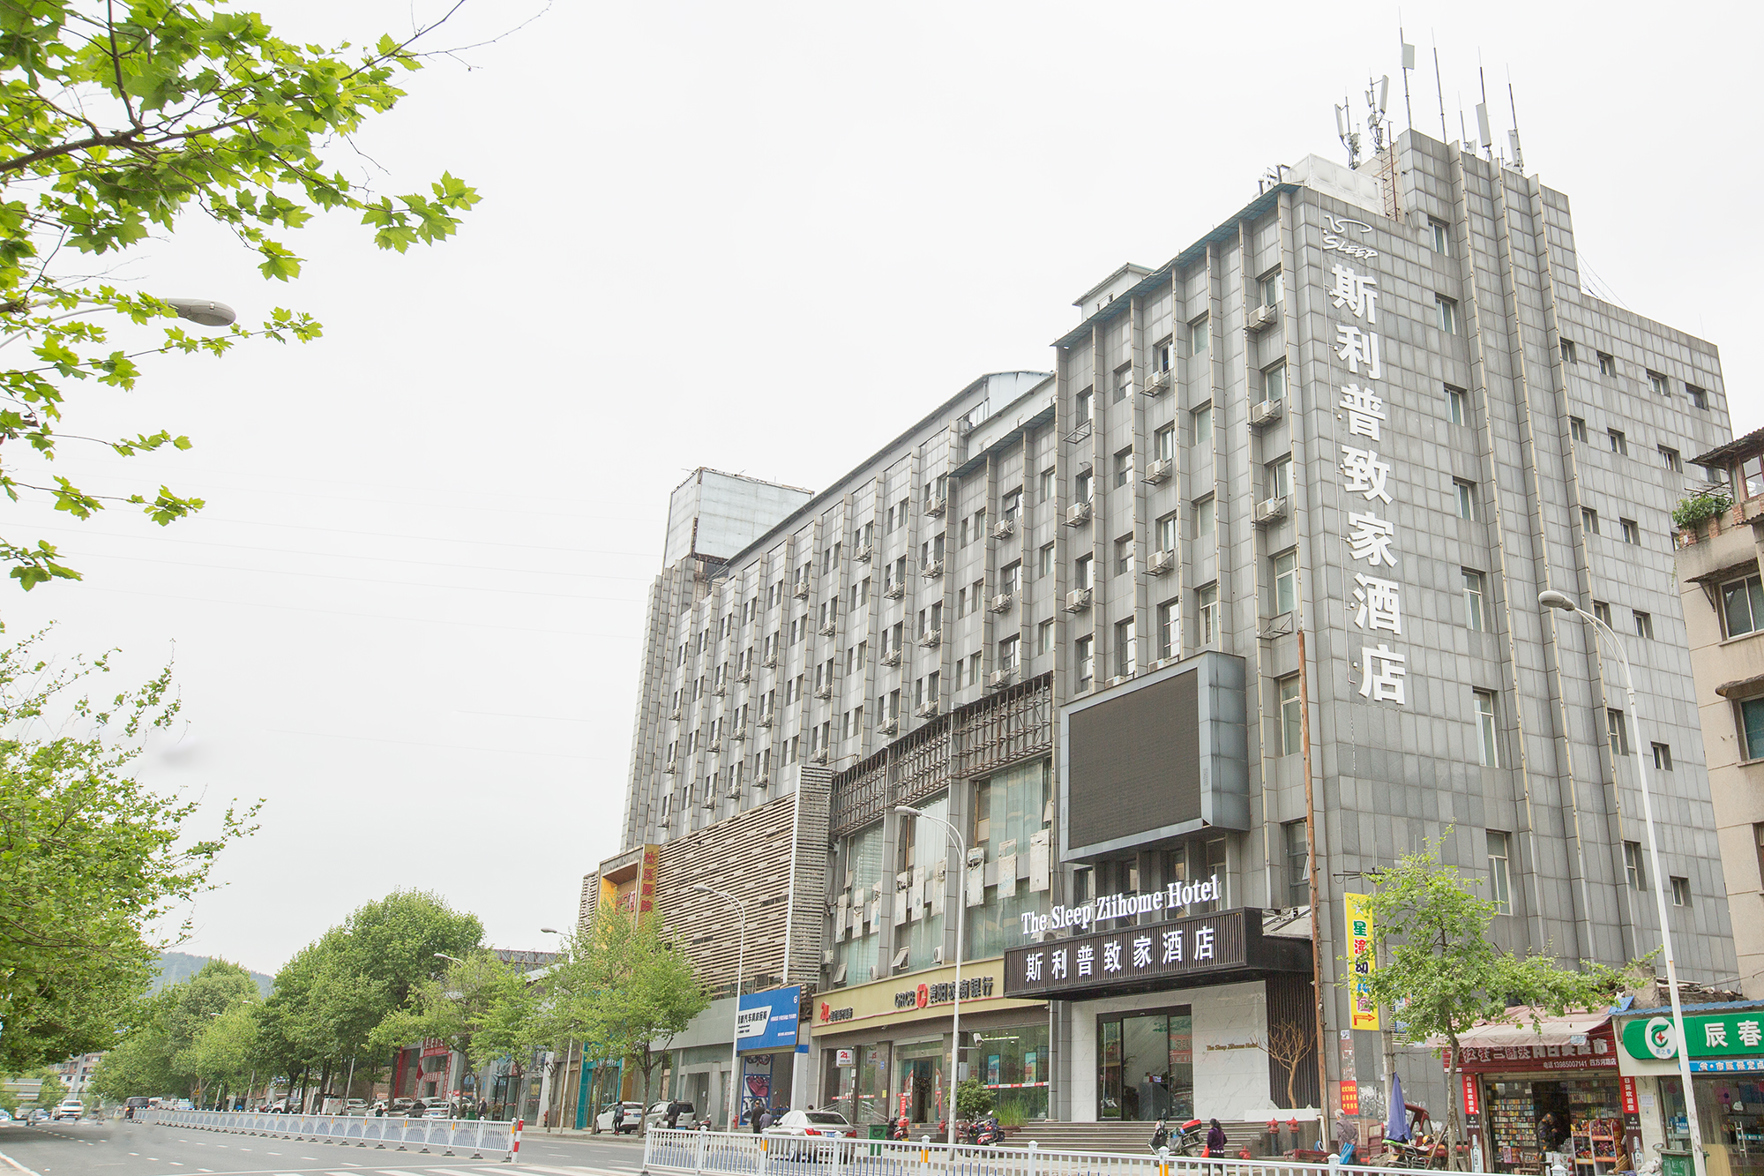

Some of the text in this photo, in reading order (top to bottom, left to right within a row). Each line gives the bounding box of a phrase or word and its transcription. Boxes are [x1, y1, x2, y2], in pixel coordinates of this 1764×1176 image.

[1322, 235, 1378, 260] SLEEP
[1331, 263, 1406, 706] 斯利普致家酒店
[1021, 874, 1221, 935] The Sleep Ziihome Hotel
[1025, 925, 1215, 983] 斯利普致家酒店
[1704, 1020, 1763, 1048] 辰春
